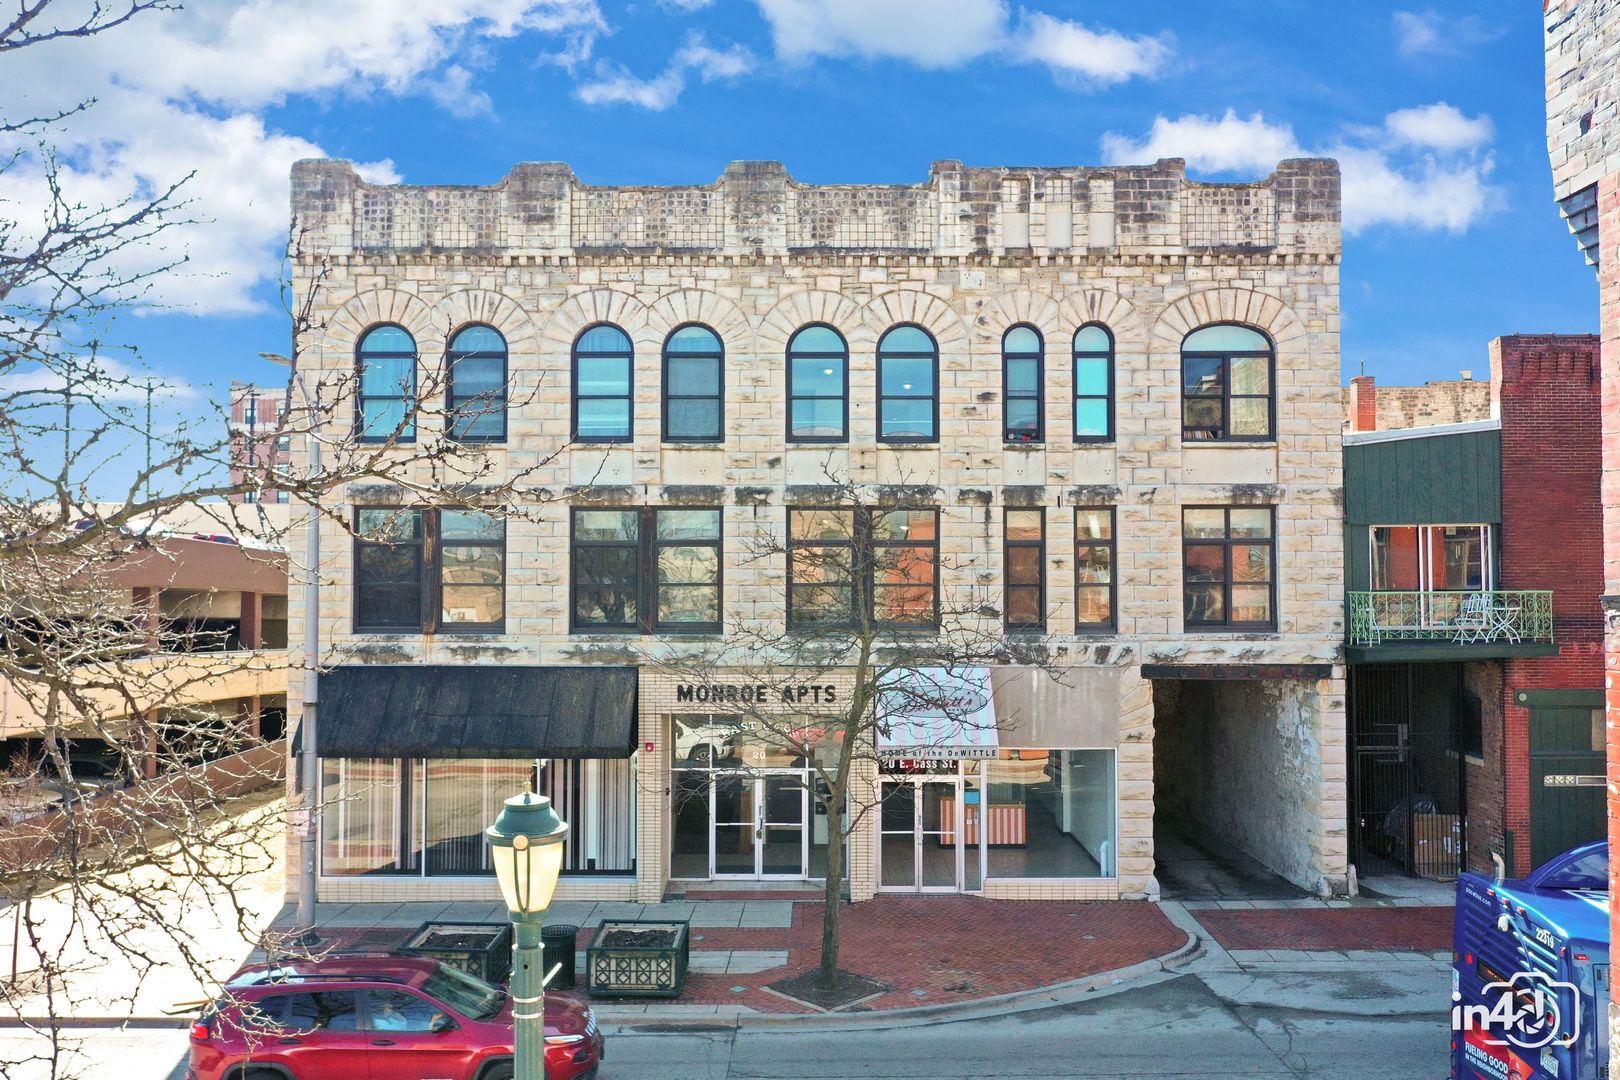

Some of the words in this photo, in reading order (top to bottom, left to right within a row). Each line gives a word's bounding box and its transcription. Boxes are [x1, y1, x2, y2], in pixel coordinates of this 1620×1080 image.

[677, 685, 767, 703] MONROE
[782, 685, 836, 703] APTS
[752, 751, 766, 760] 20
[927, 749, 942, 757] the
[948, 749, 996, 757] DeWITTLE
[942, 759, 957, 769] St.
[1465, 1041, 1488, 1063] FUELING
[1488, 1055, 1509, 1074] GOOD
